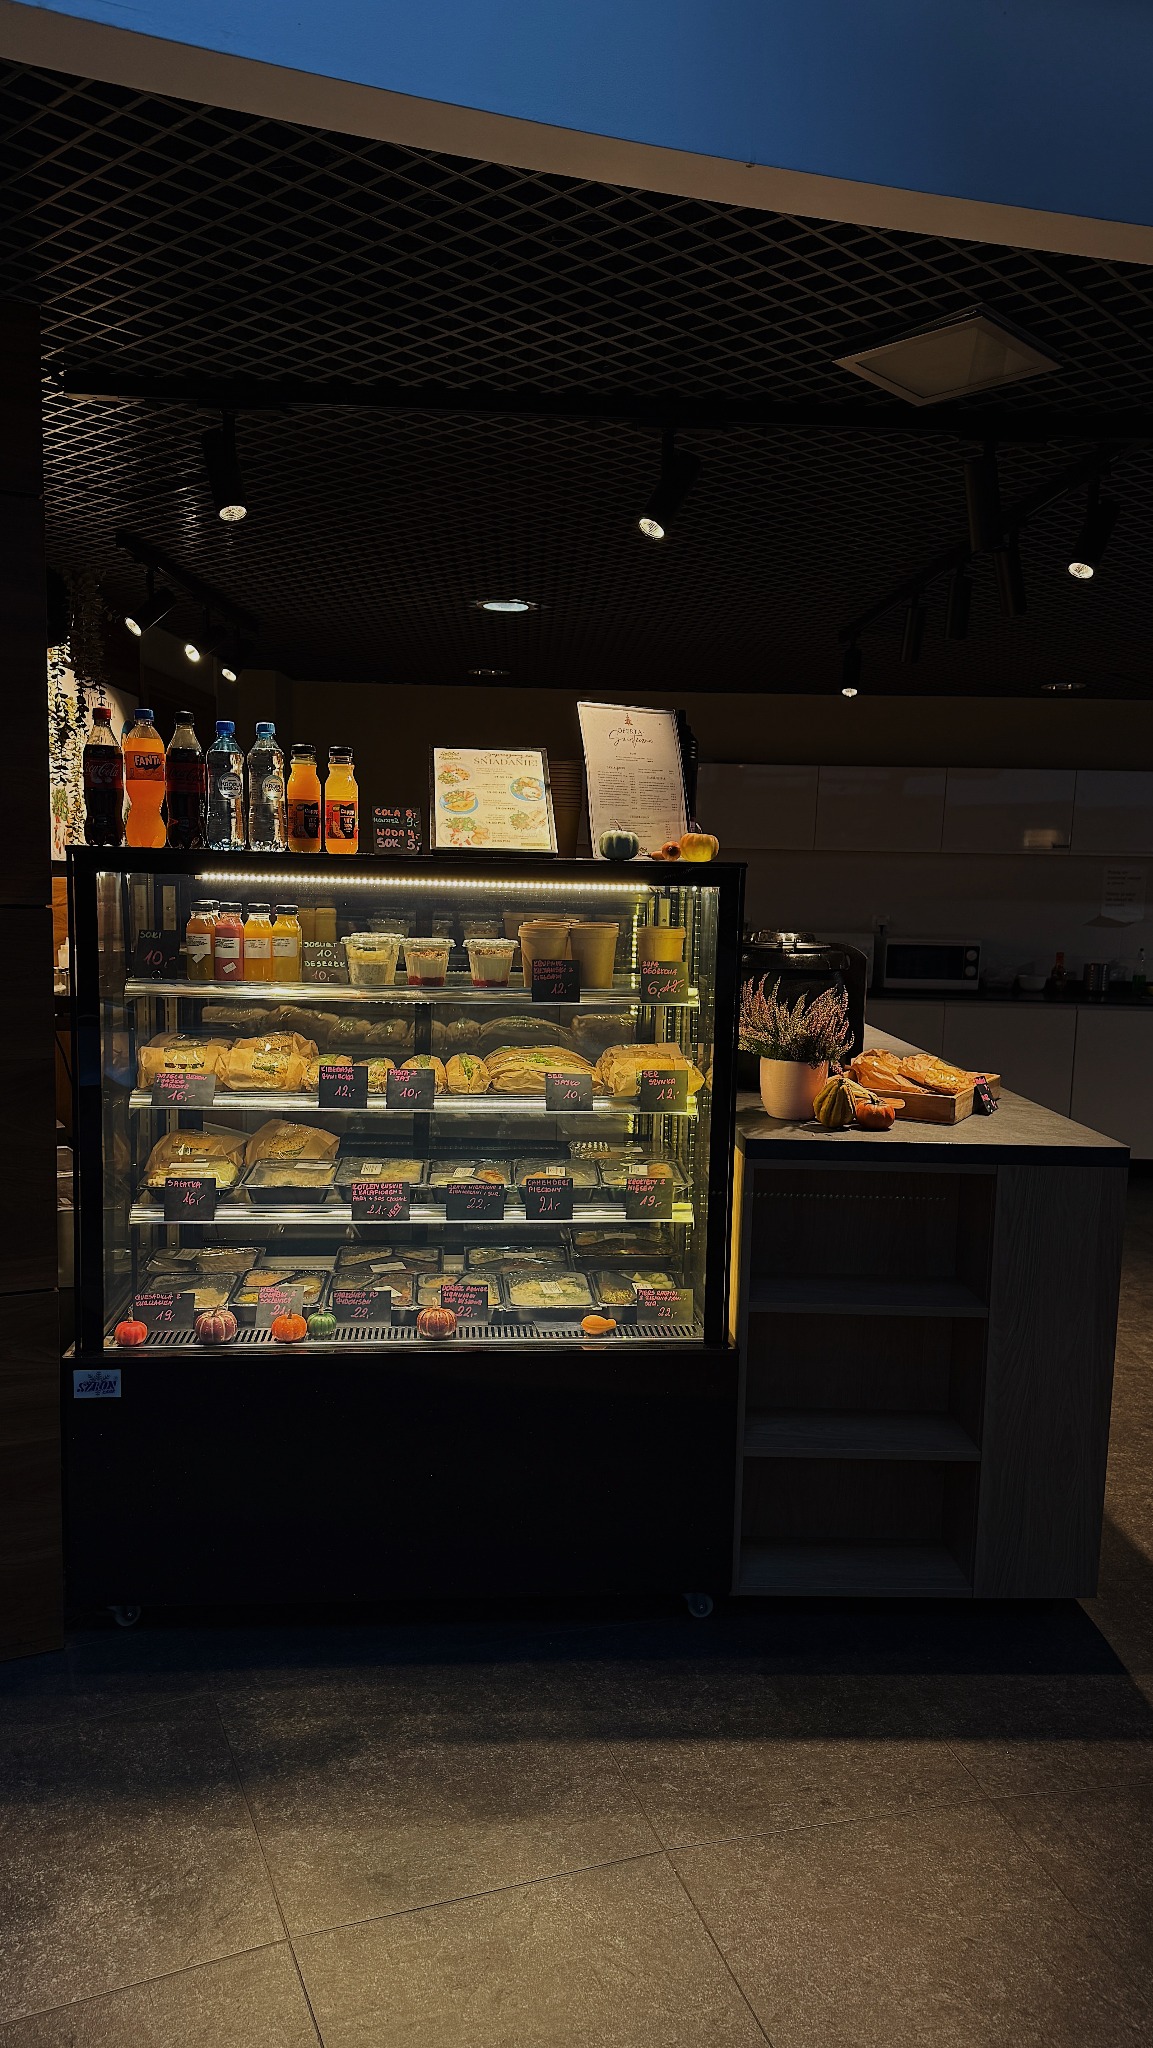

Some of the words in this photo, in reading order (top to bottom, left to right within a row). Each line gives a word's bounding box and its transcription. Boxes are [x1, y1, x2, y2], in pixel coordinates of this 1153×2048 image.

[374, 808, 401, 817] COLA
[377, 828, 405, 837] WODA
[377, 838, 401, 848] SOK
[140, 931, 162, 939] SOKI
[643, 1070, 660, 1078] SER
[167, 1179, 203, 1189] SAŁATKA
